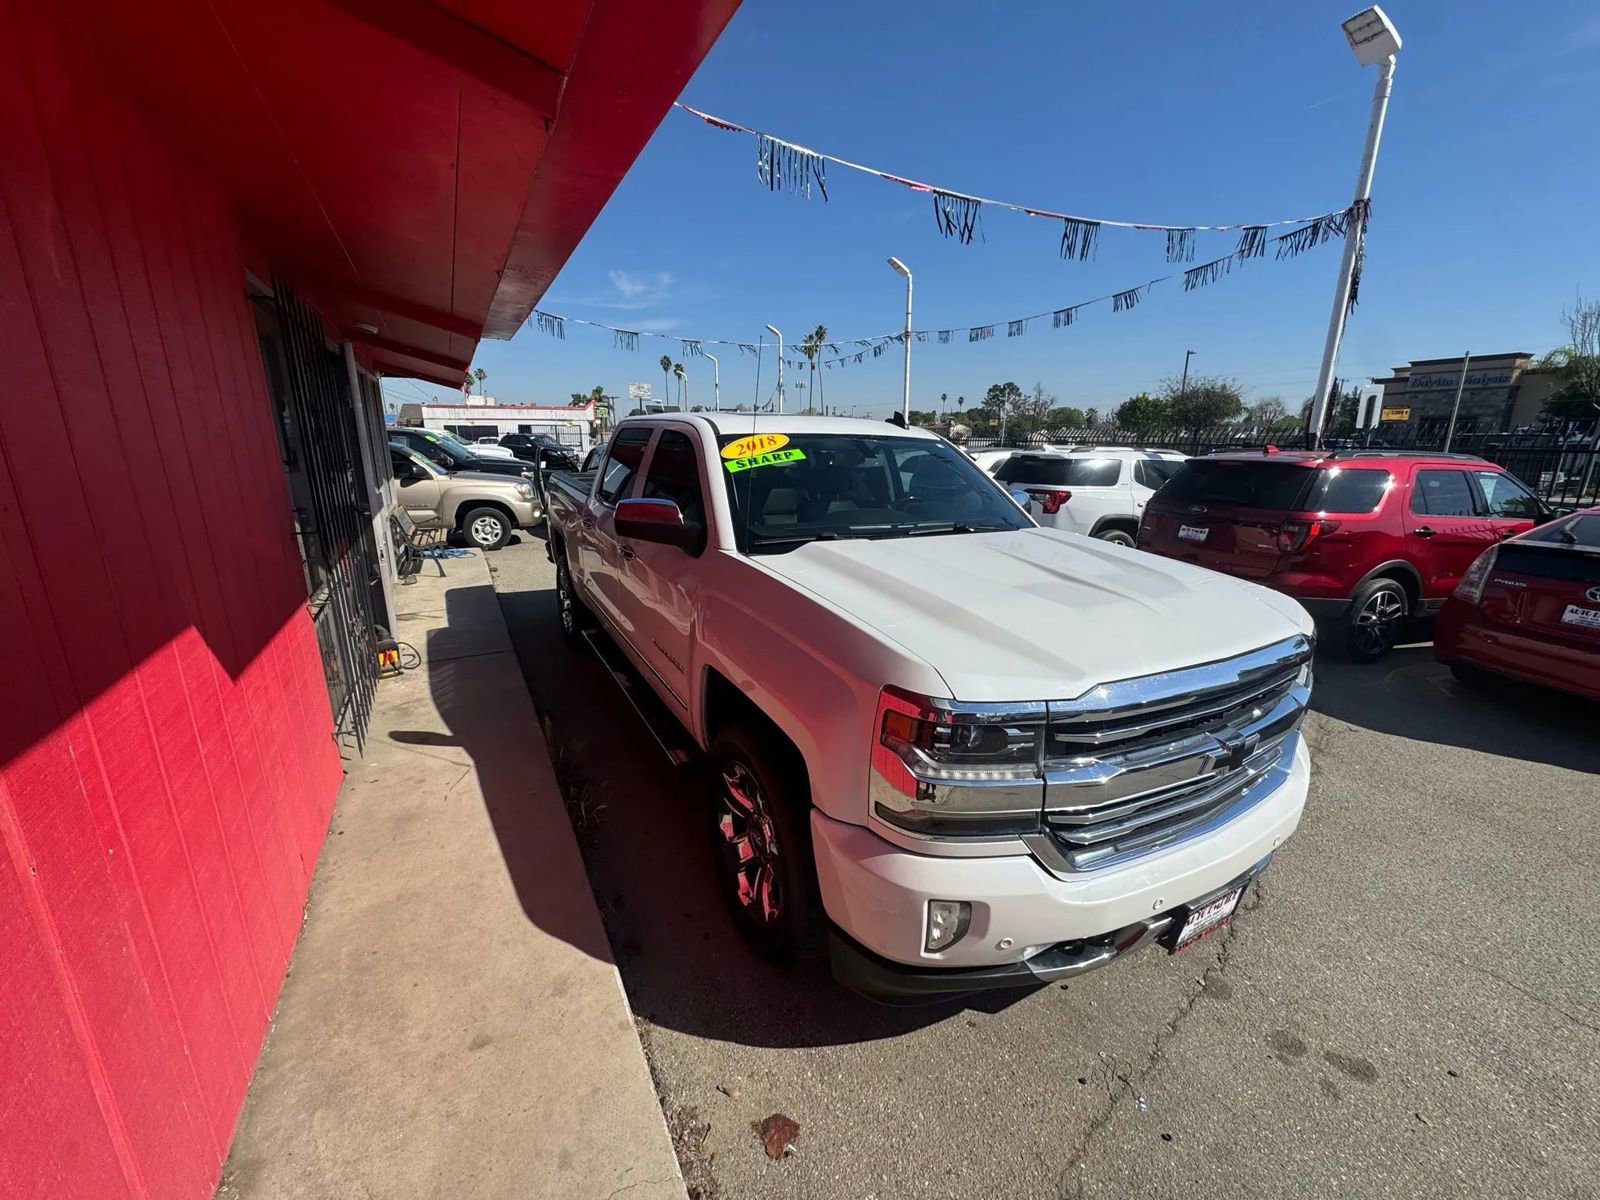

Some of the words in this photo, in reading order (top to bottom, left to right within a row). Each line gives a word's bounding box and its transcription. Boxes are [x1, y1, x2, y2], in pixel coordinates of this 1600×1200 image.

[735, 435, 777, 457] 2018
[735, 451, 794, 469] SHARP
[1567, 606, 1592, 617] AUTO
